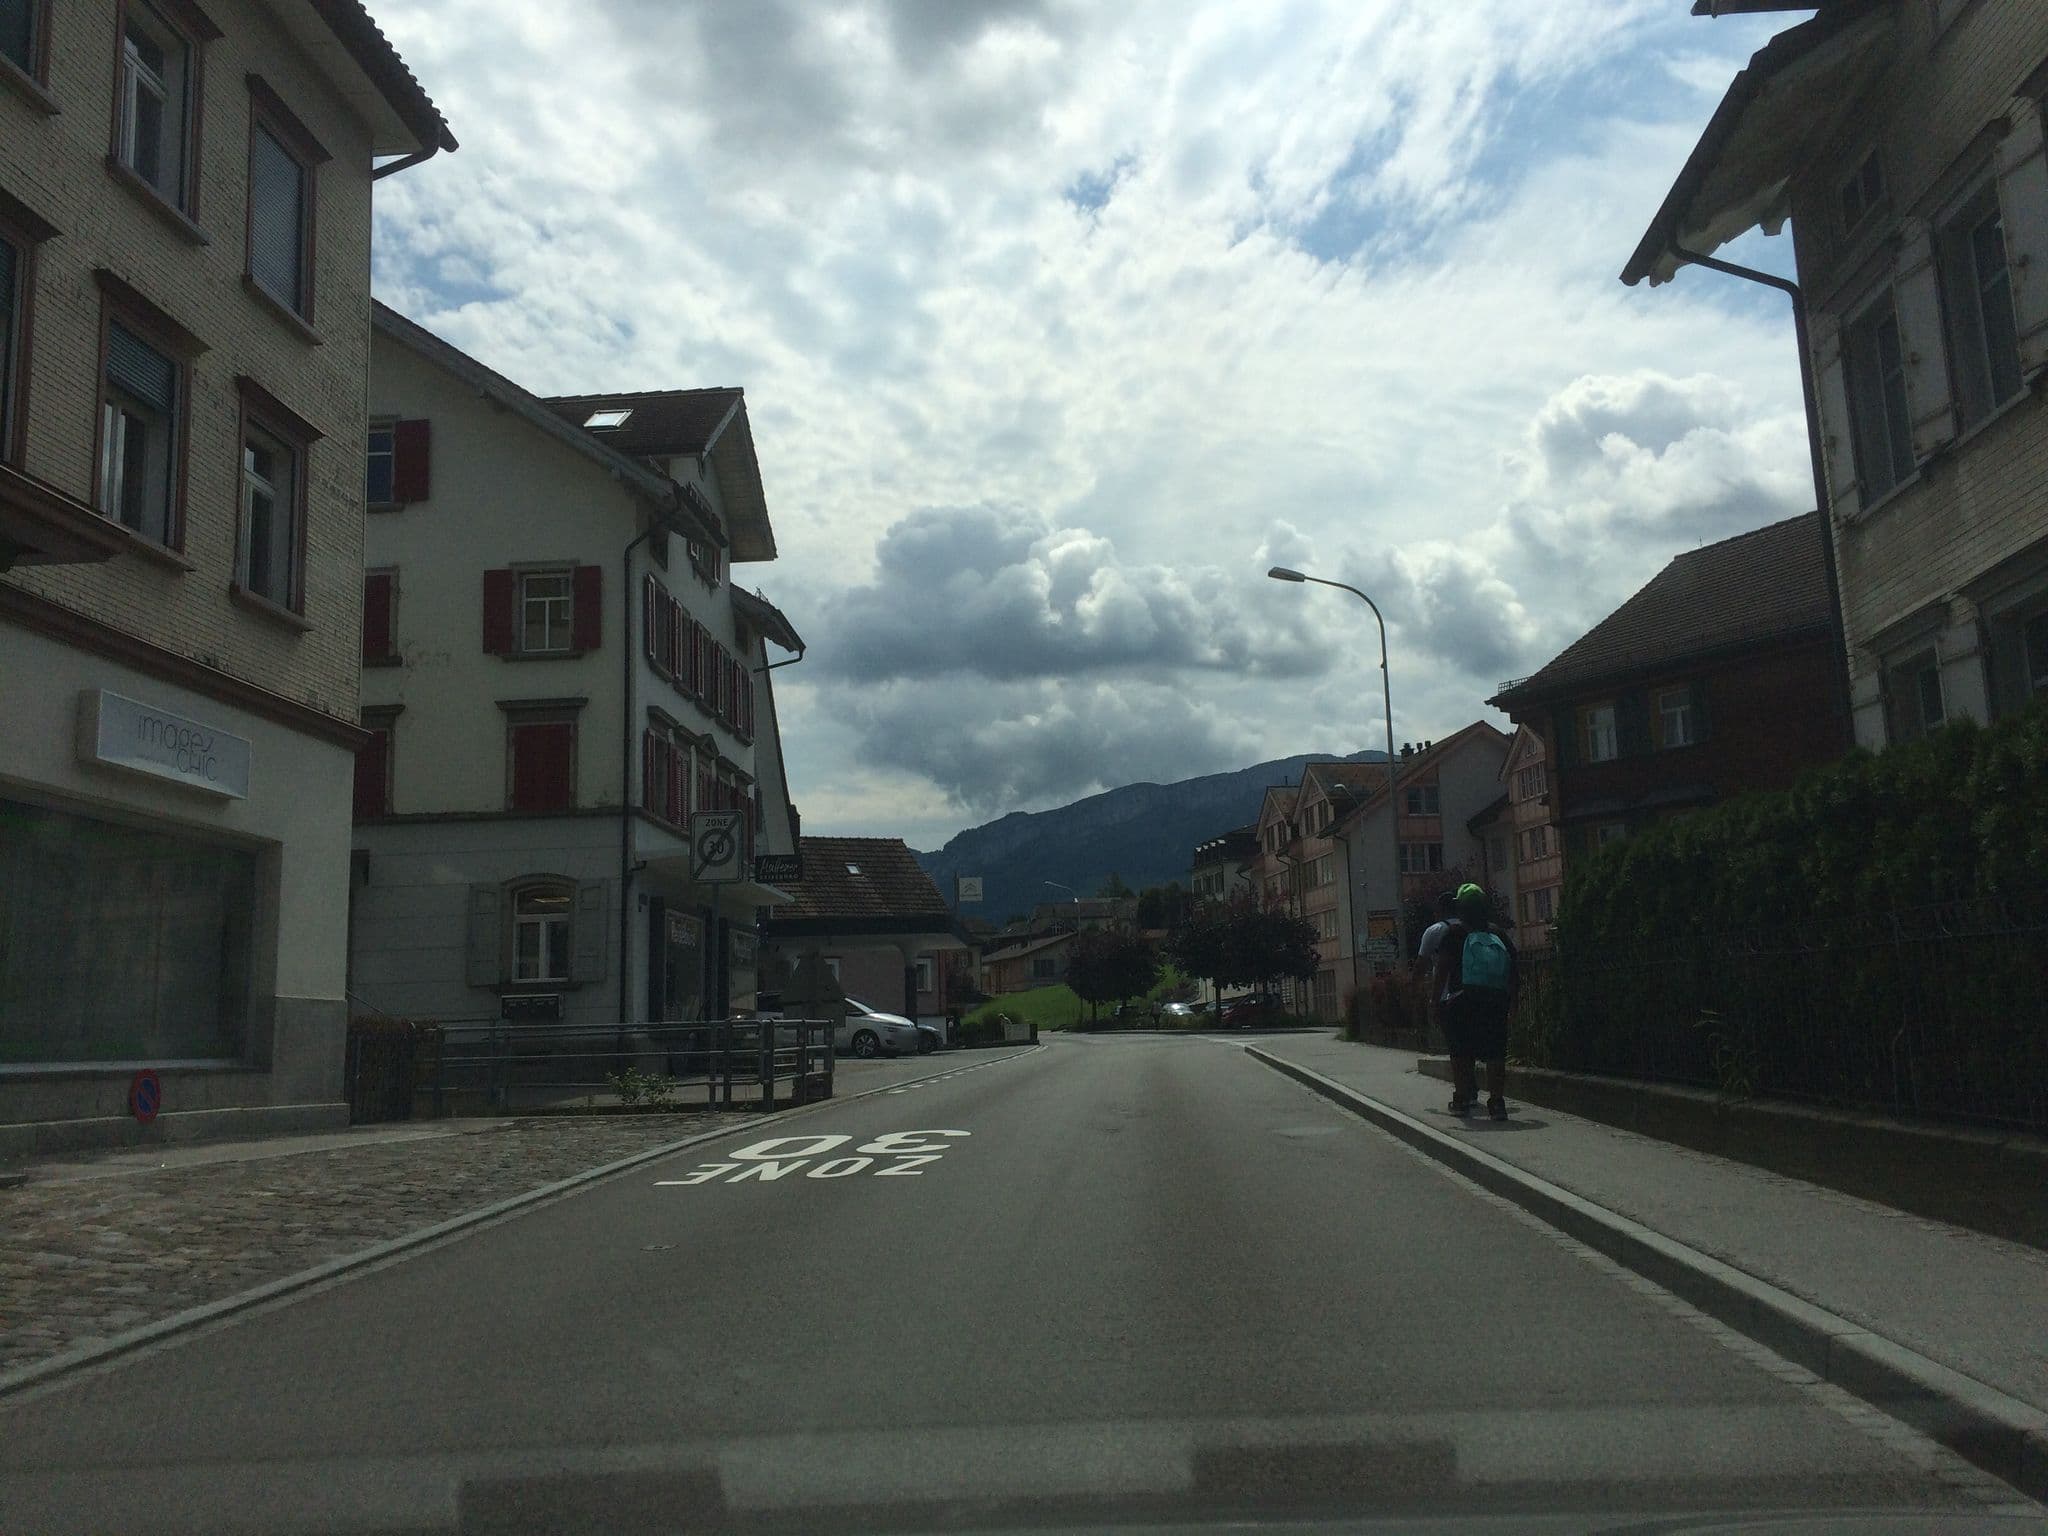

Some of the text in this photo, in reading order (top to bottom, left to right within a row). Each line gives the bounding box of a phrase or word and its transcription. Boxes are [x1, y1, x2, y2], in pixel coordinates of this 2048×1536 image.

[176, 748, 217, 781] CHIC
[705, 818, 729, 827] ZONE
[708, 840, 725, 854] 30
[729, 1129, 971, 1160] 30
[653, 1155, 943, 1186] ZONE
